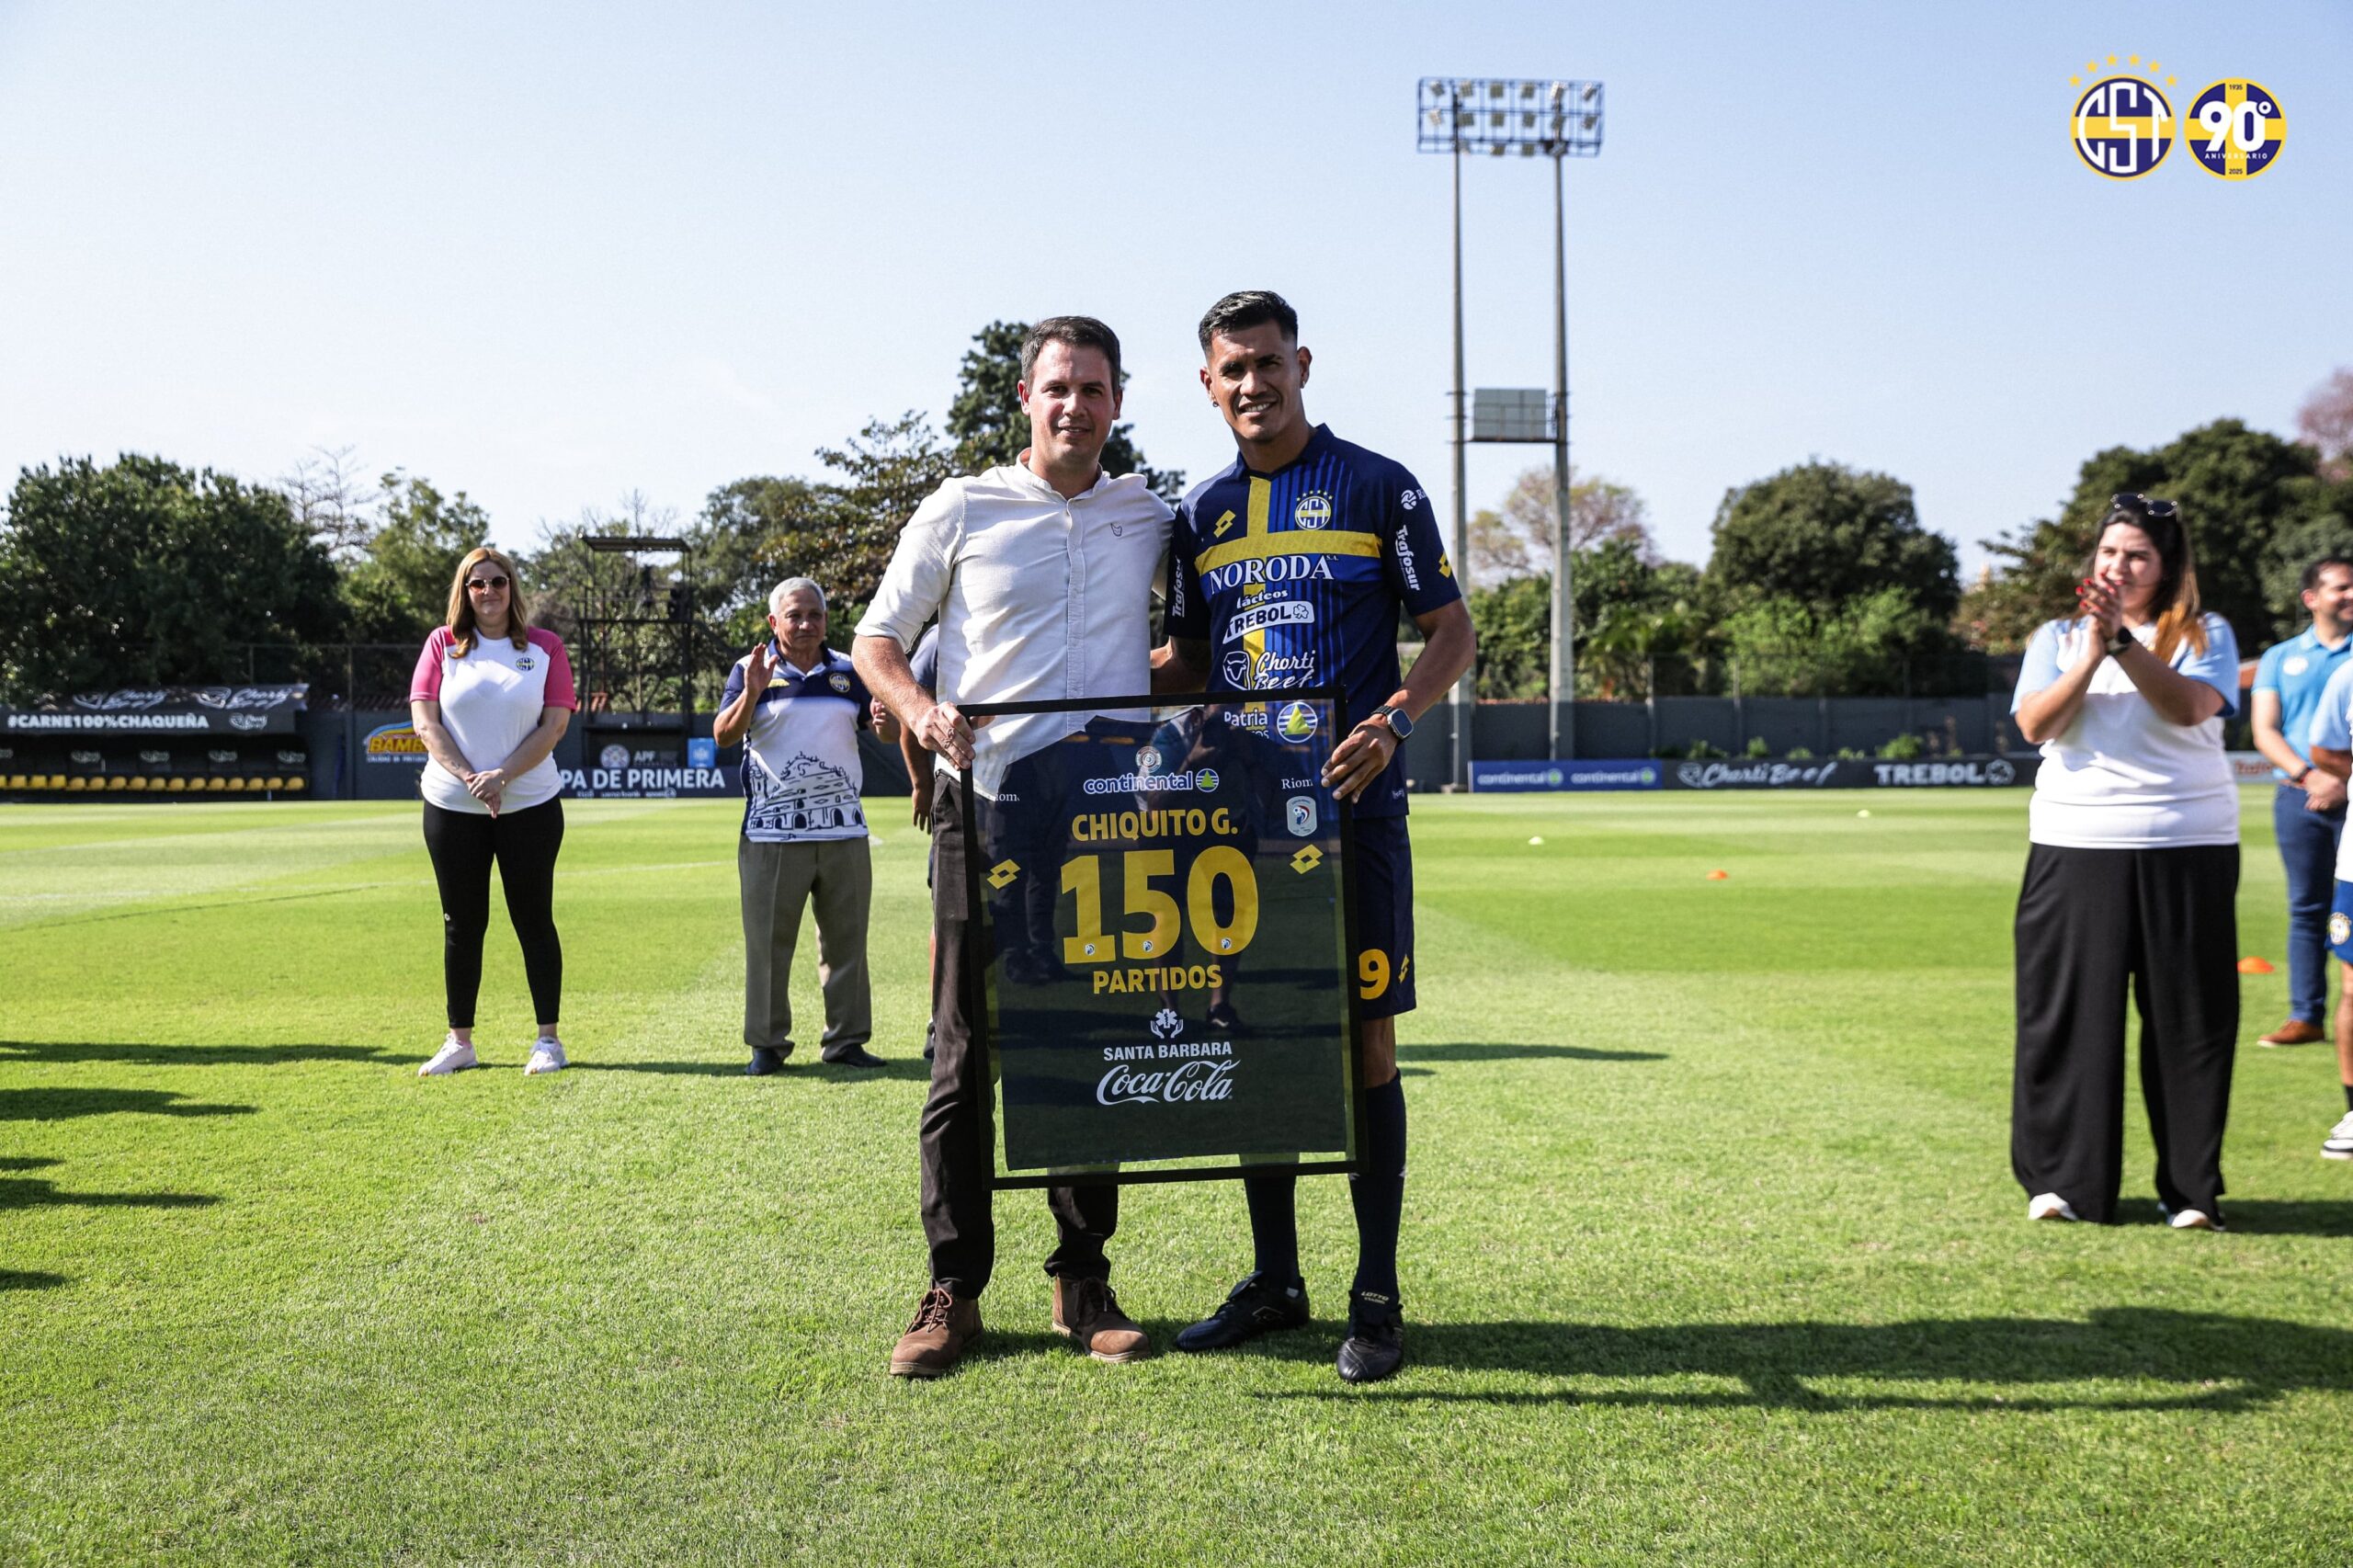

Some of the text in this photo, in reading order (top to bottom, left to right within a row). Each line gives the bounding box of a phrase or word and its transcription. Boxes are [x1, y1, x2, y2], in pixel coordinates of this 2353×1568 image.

[1395, 525, 1420, 590] Trafosur
[1210, 555, 1335, 595] NORODA
[1256, 650, 1315, 676] Chorti
[369, 736, 427, 753] BAMB
[560, 768, 726, 790] PA DE PRIMERA
[1084, 771, 1193, 794] continental
[1873, 763, 1984, 786] TREBOL
[1072, 808, 1238, 841] CHIQUITO G.
[1061, 846, 1258, 964] 150
[1093, 965, 1222, 994] PARTIDOS
[1104, 1041, 1232, 1061] SANTA BARBARA
[1097, 1060, 1241, 1105] Coca-Cola
